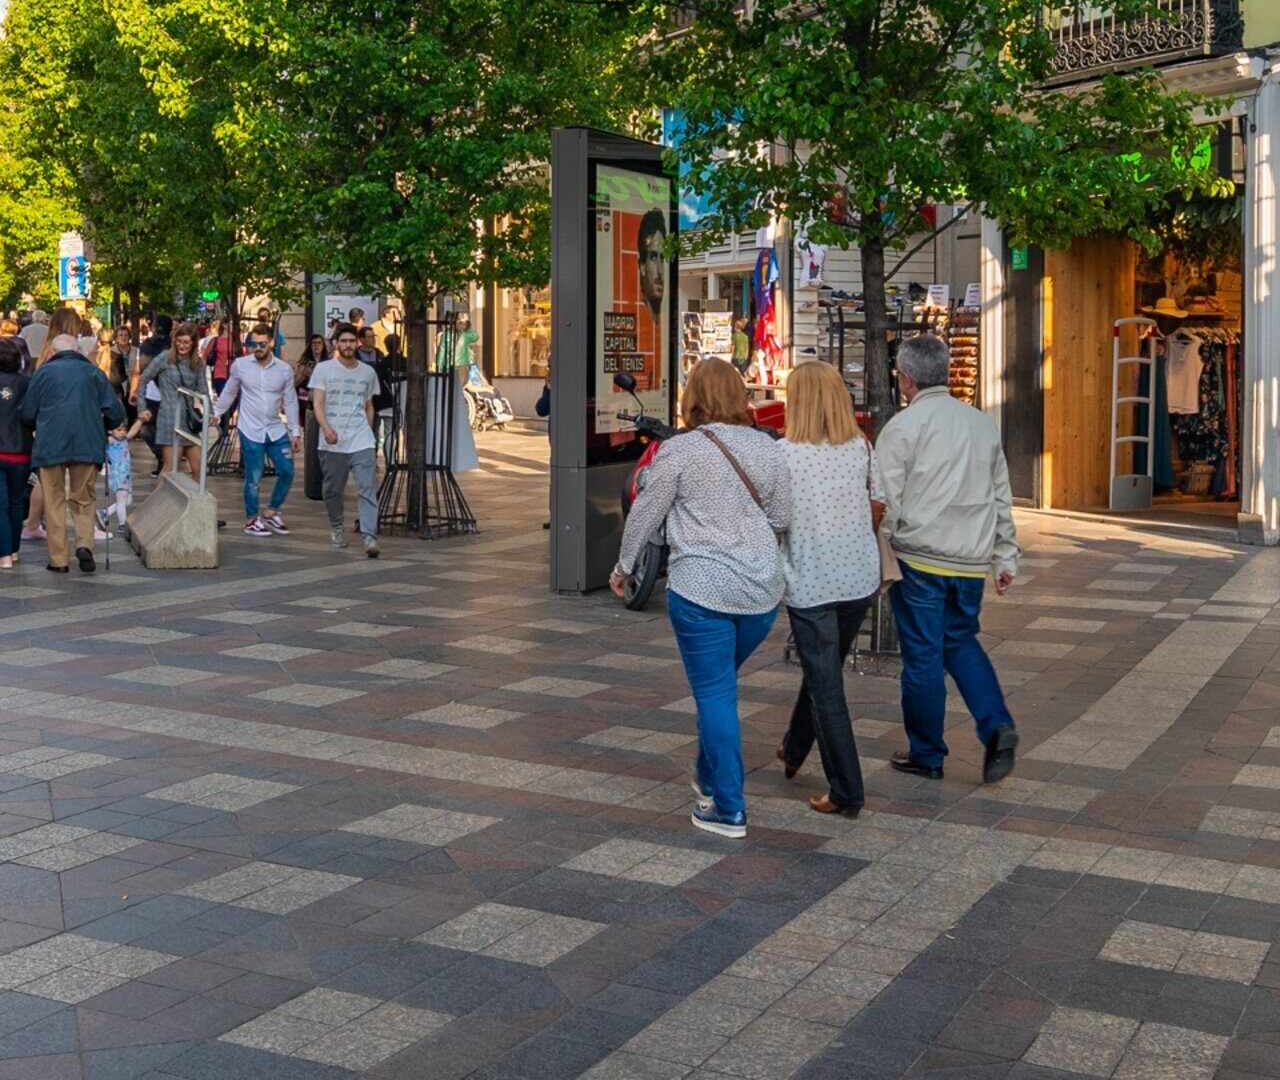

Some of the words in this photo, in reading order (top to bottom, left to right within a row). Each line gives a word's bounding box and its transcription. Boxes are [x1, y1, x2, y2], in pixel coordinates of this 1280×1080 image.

[605, 316, 635, 330] MADRID
[604, 335, 636, 351] CAPITAL
[604, 358, 619, 371] DEL
[622, 358, 644, 372] TENIS
